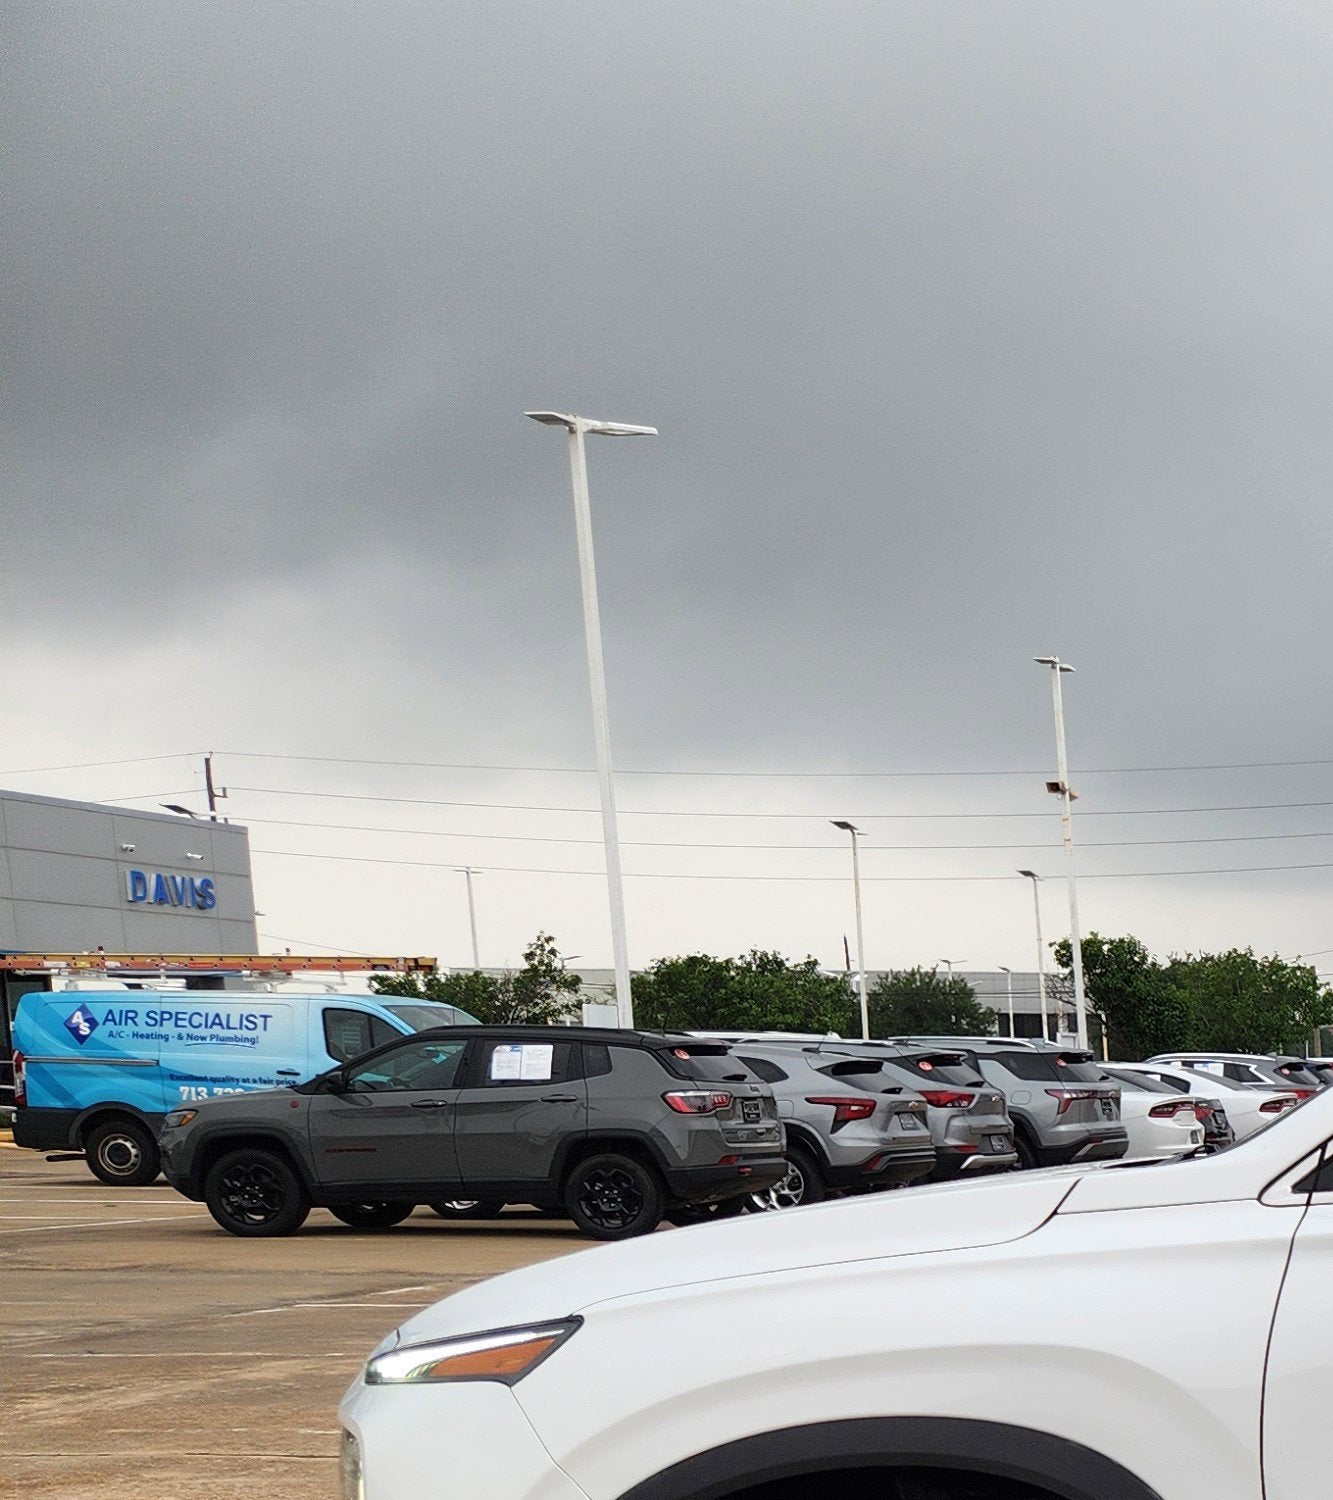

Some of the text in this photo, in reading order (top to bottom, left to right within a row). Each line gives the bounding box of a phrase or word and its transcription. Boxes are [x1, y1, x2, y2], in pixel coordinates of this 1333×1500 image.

[128, 869, 216, 910] DAVIS
[102, 1009, 273, 1031] AIR SPECIALIST
[108, 1030, 124, 1039] A/C
[131, 1030, 169, 1042] Heating
[176, 1032, 184, 1040] &
[186, 1033, 207, 1042] Now
[209, 1033, 260, 1045] Plumbing!
[168, 1073, 207, 1082] Excellent
[208, 1075, 240, 1085] quality
[242, 1076, 251, 1084] at
[259, 1076, 274, 1085] fair
